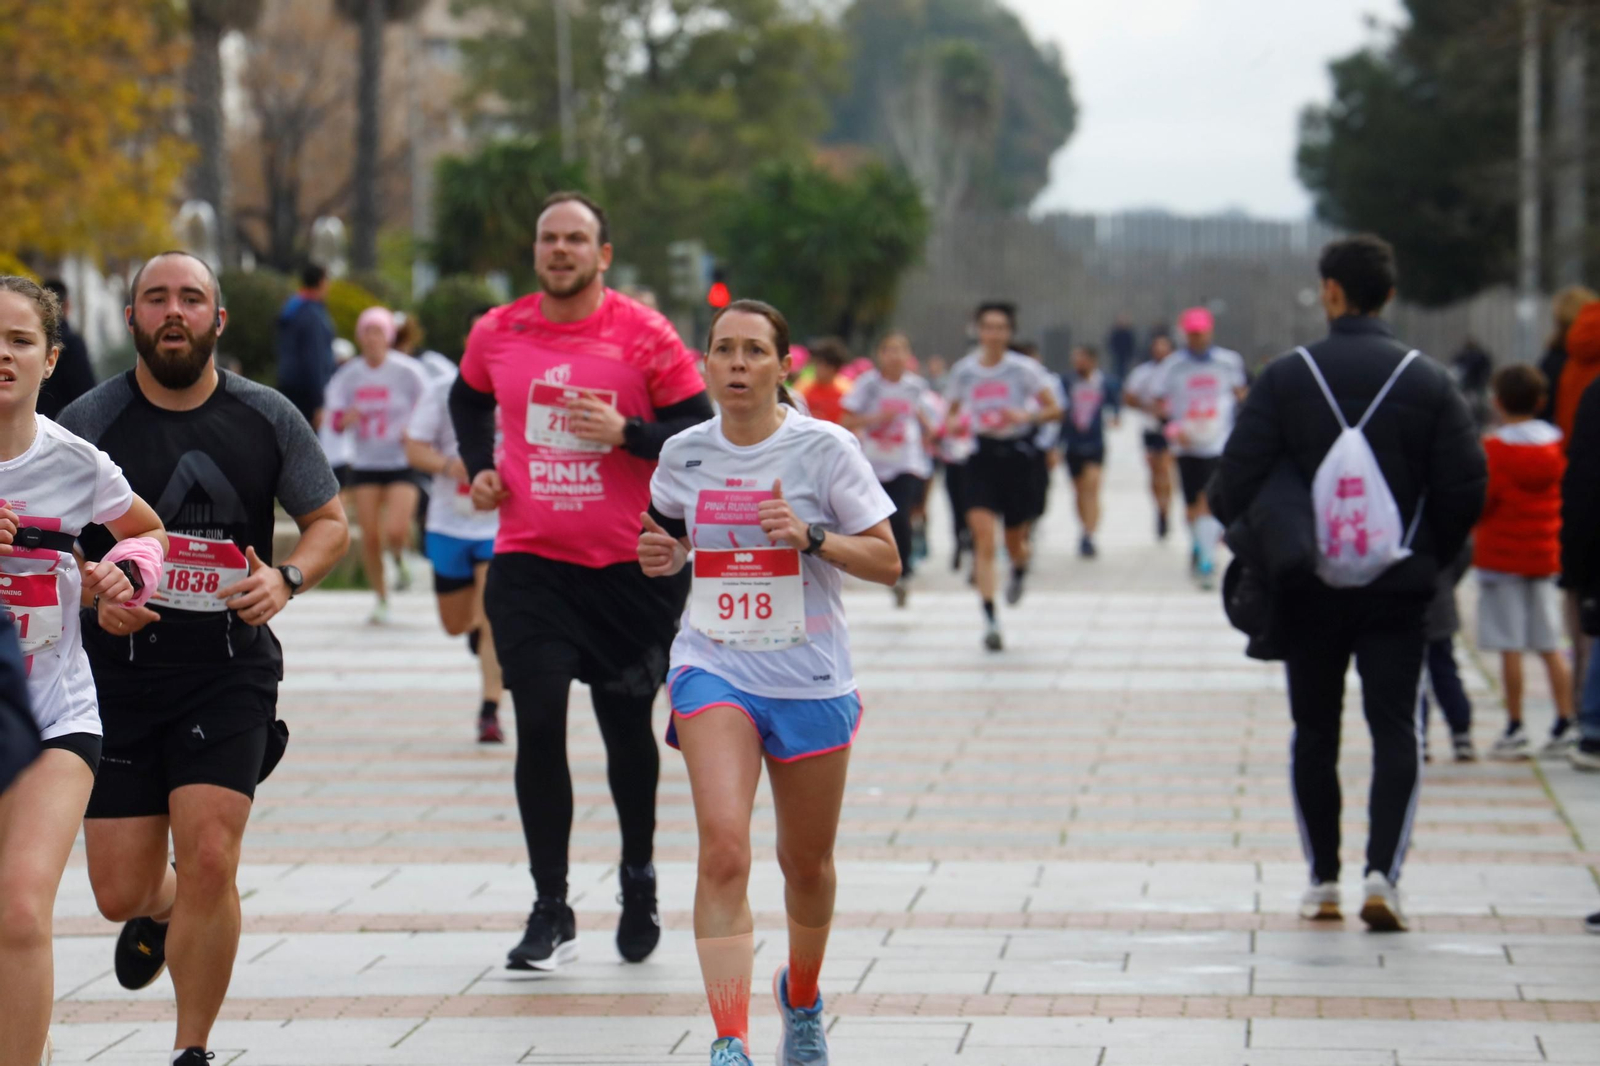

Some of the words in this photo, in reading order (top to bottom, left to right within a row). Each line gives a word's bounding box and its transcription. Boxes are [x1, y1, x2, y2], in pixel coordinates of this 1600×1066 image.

[529, 461, 602, 482] PINK
[530, 482, 604, 495] RUNNING
[704, 502, 727, 511] PINK
[728, 502, 759, 512] RUNNI
[189, 541, 208, 552] 100
[734, 553, 754, 563] 100
[166, 569, 220, 593] 1838
[718, 593, 772, 620] 918
